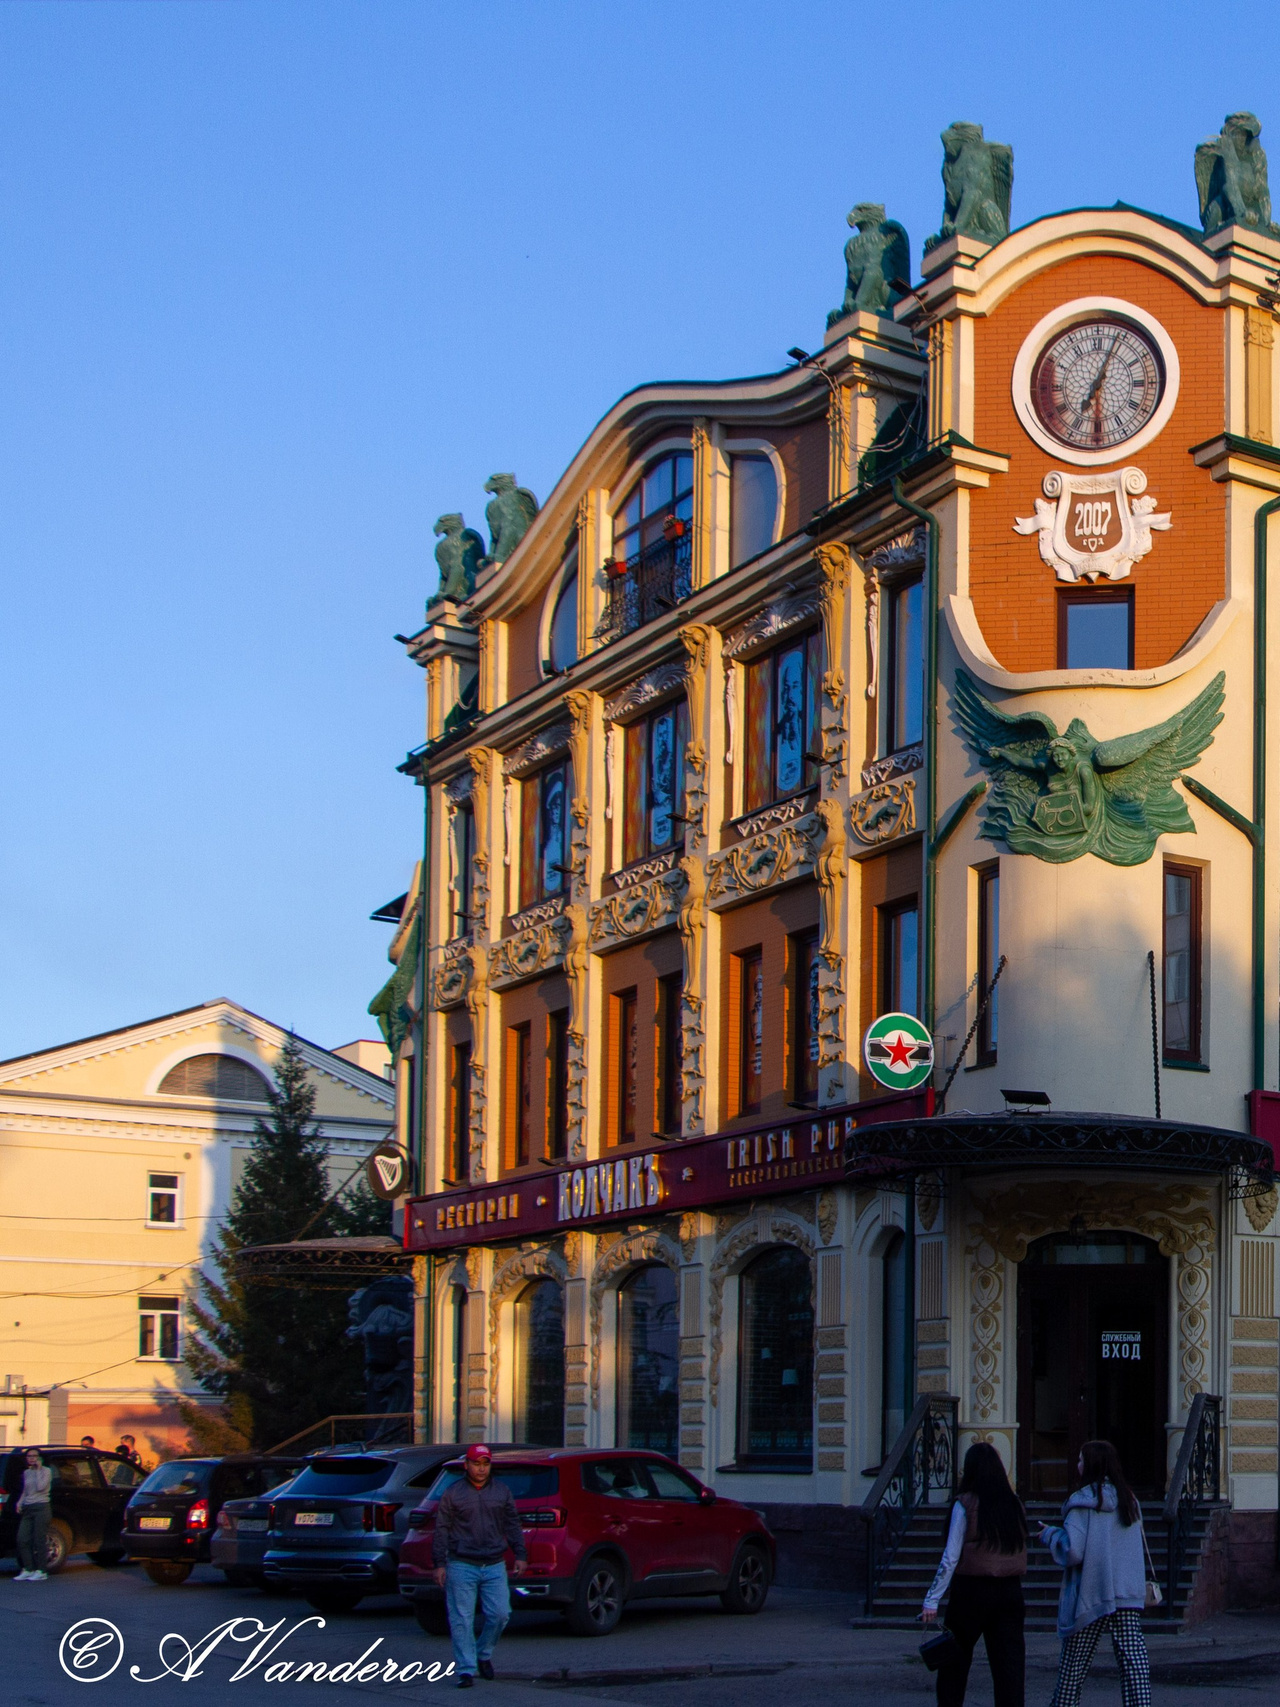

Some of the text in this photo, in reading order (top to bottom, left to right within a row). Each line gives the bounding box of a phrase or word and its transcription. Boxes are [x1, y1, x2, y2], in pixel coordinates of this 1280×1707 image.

[1075, 502, 1112, 537] 2007
[727, 1129, 794, 1169] IRISH
[558, 1154, 664, 1222] КОЛЧАКЪ
[436, 1193, 519, 1231] РЕСТОРАН
[1101, 1333, 1141, 1342] СЛУЖЕБНЫЙ
[1102, 1343, 1141, 1360] ВХОД
